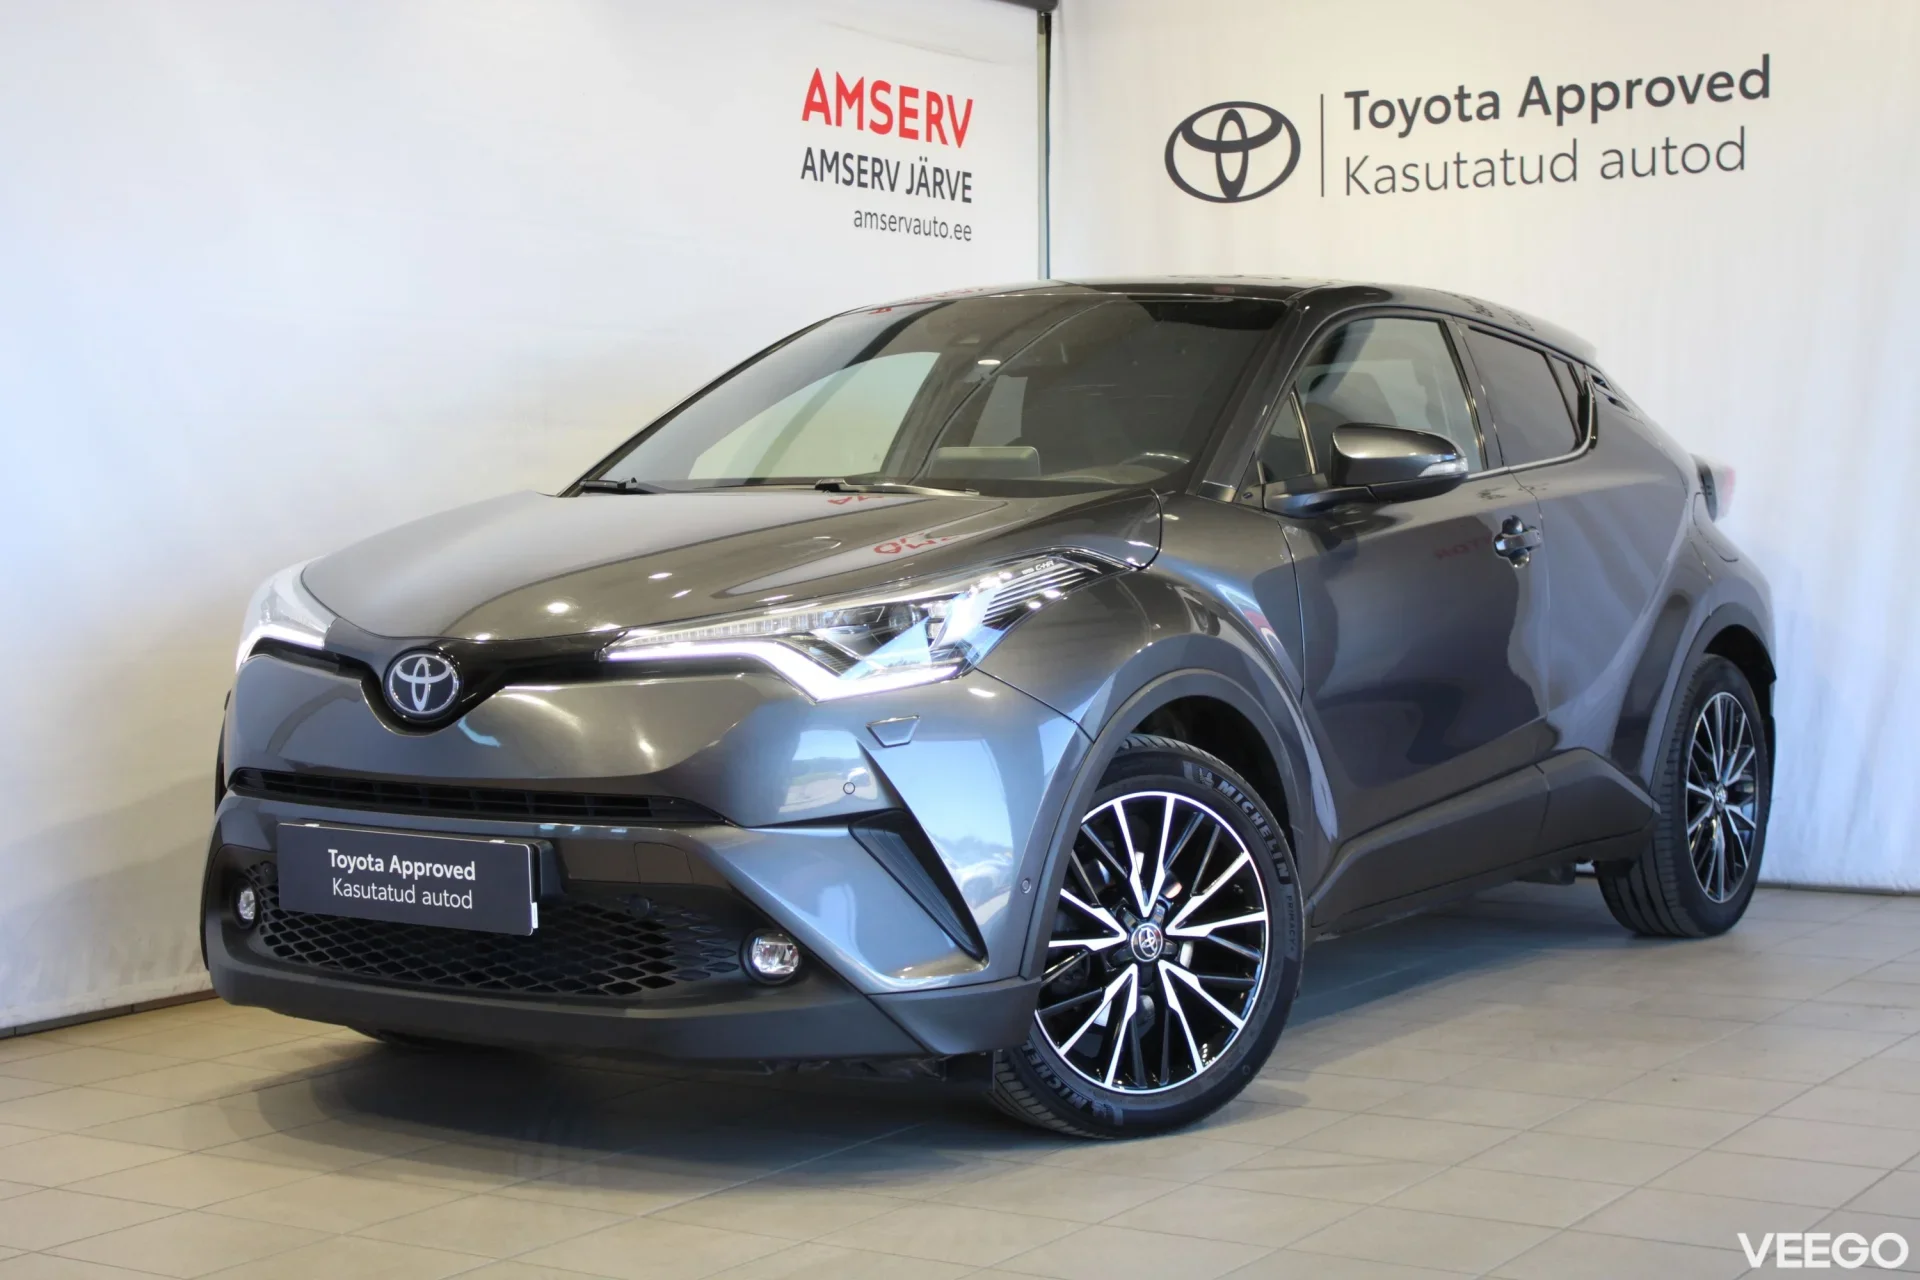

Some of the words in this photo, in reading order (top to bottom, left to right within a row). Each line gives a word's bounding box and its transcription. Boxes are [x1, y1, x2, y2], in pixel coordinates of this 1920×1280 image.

[802, 67, 973, 149] AMSERV
[1345, 84, 1500, 139] Toyota
[1517, 53, 1770, 127] Approved
[801, 146, 901, 193] AMSERV
[905, 155, 972, 204] JÄRVE
[1346, 138, 1578, 196] Kasutatud
[1599, 126, 1745, 180] autod
[853, 209, 972, 241] amservauto.ee
[1217, 780, 1290, 878] MICHELIN
[327, 848, 384, 874] Toyota
[389, 854, 476, 881] Approved
[332, 877, 416, 904] Kasutatud
[421, 889, 473, 909] autod
[1021, 1042, 1088, 1109] MICHEL
